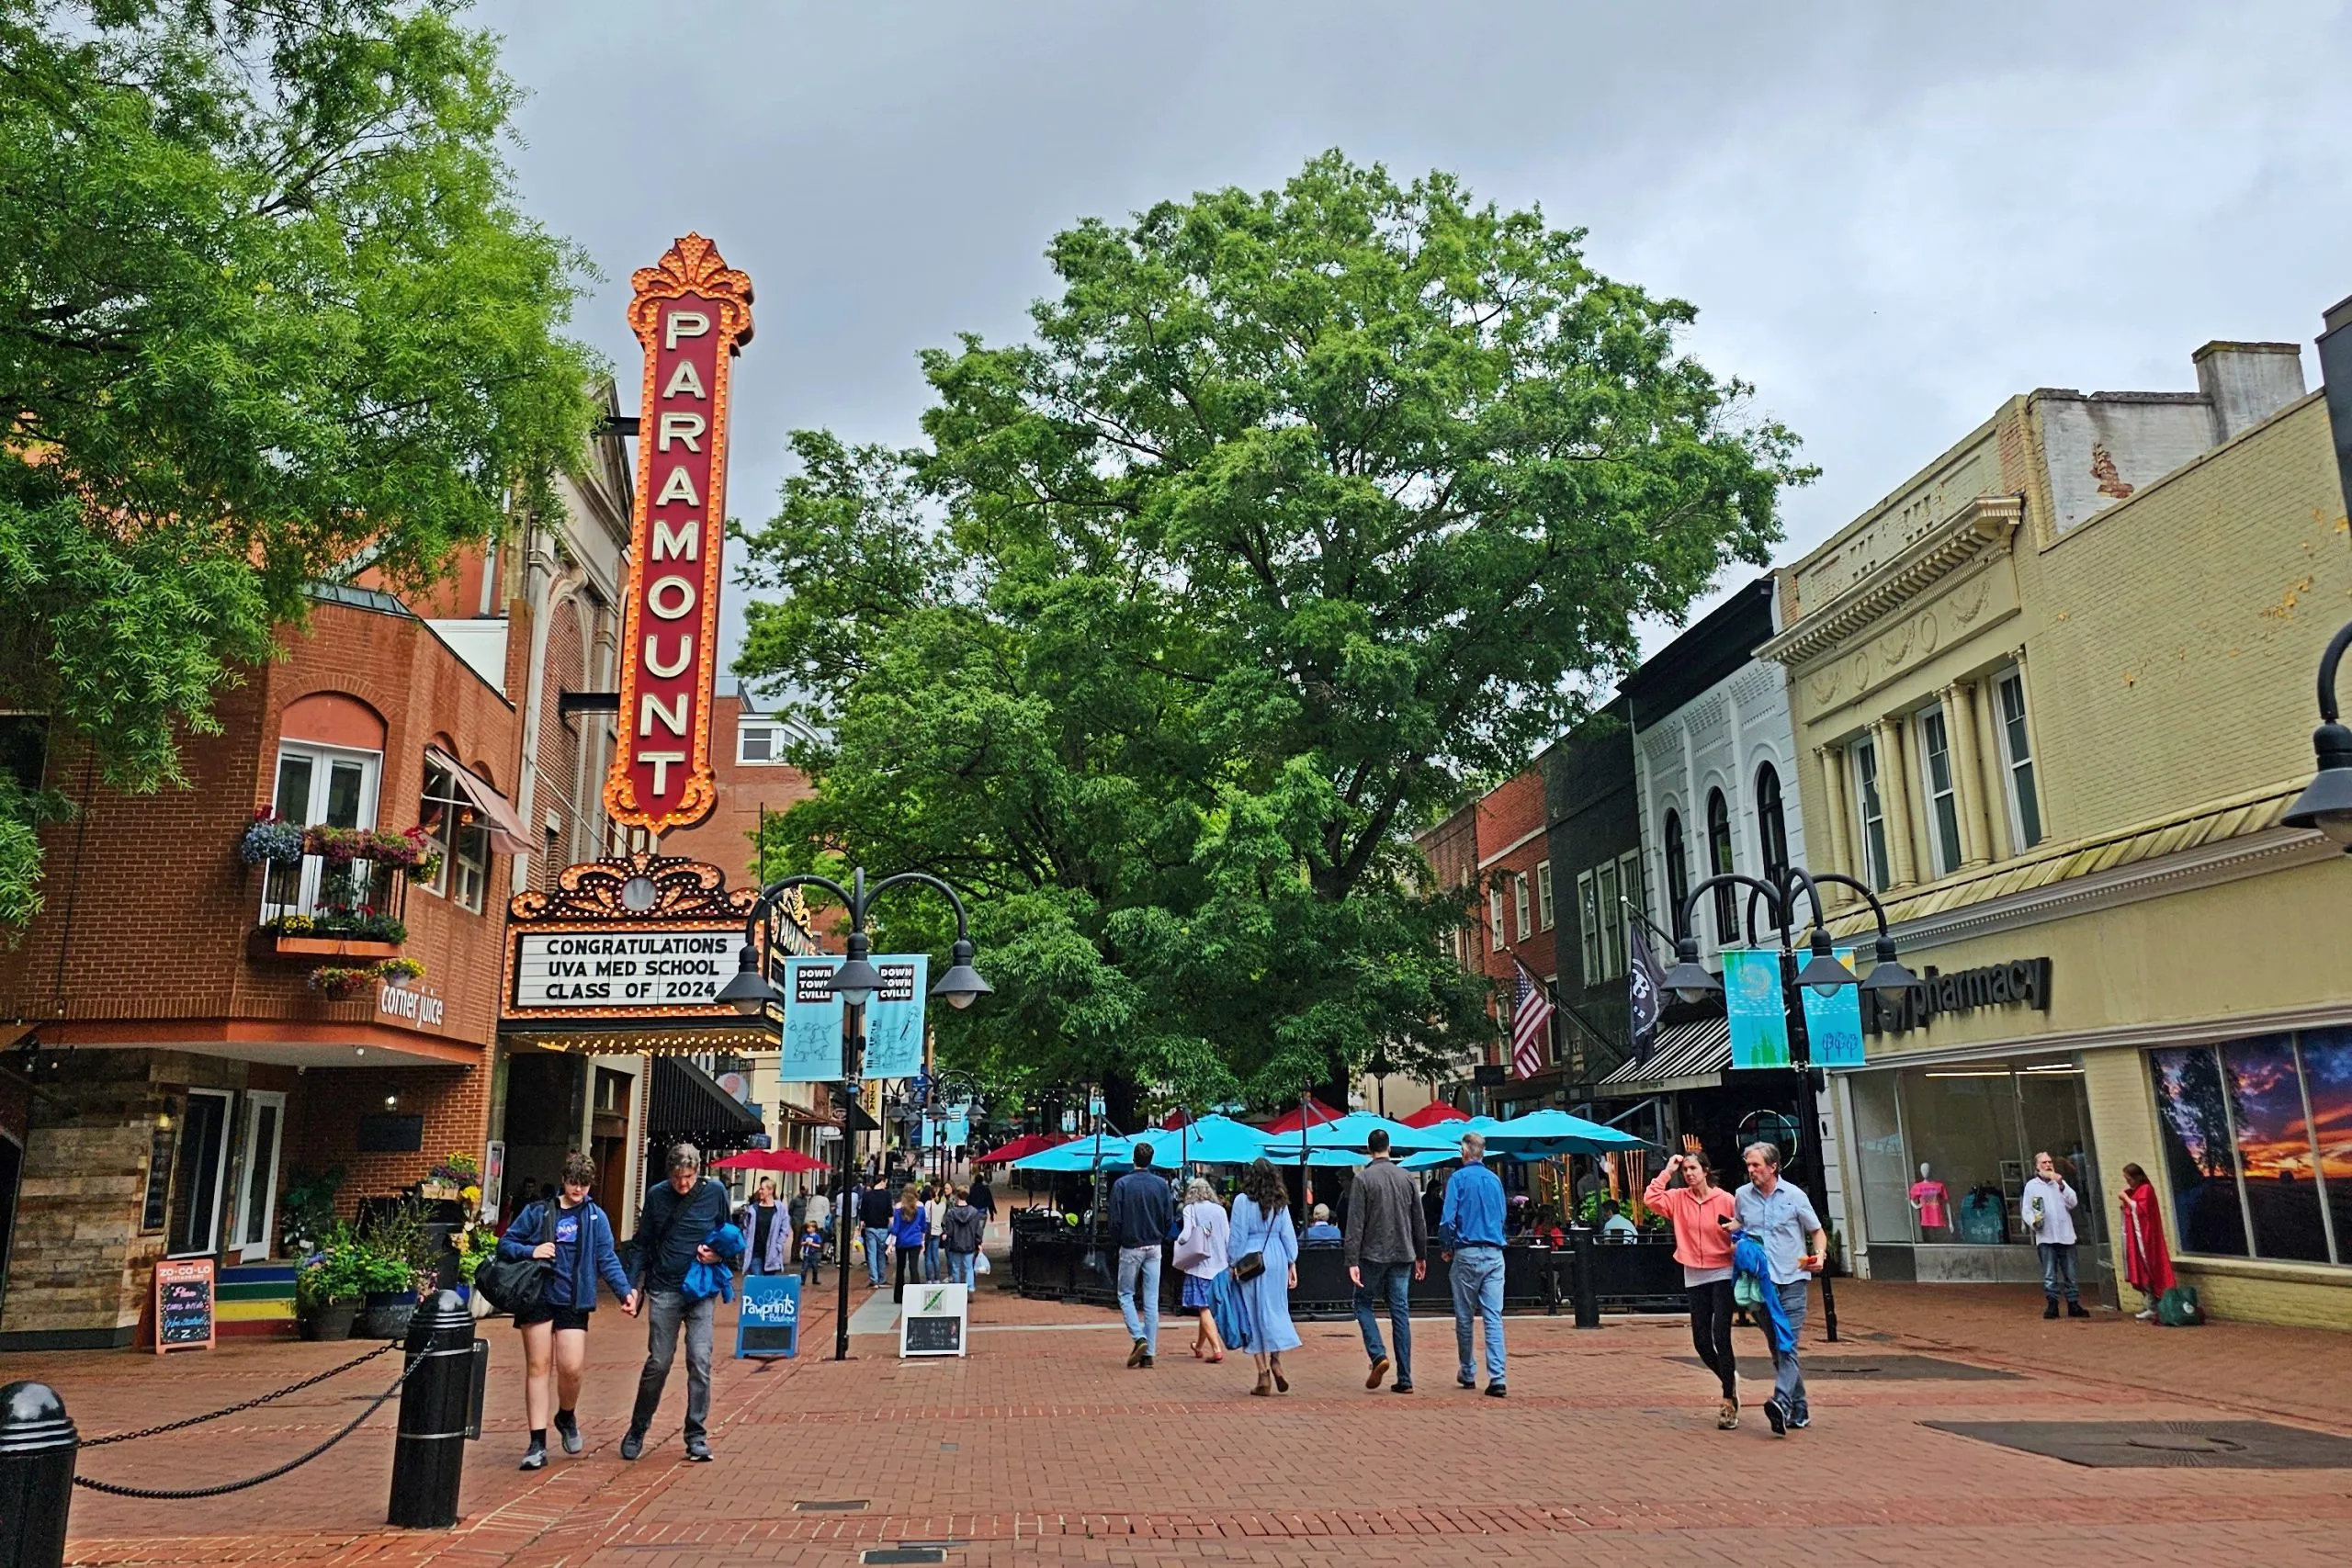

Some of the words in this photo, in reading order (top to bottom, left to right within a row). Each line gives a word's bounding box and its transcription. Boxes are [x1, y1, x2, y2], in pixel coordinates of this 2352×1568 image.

[637, 310, 710, 796] PARAMOUNT
[547, 938, 728, 955] CONGRATULATIONS
[548, 961, 587, 976] UVA
[596, 961, 637, 976] MED
[645, 960, 719, 976] SCHOOL
[798, 969, 831, 978] DOWN
[880, 968, 912, 977] DOWN
[546, 982, 610, 999] CLASS
[625, 982, 651, 998] OF
[666, 981, 716, 998] 2024
[884, 978, 911, 987] OWN
[798, 990, 831, 999] CVILLE
[880, 988, 911, 998] CVILLE
[381, 985, 419, 1019] corner
[416, 986, 443, 1029] juice
[742, 1293, 795, 1321] Pawprints
